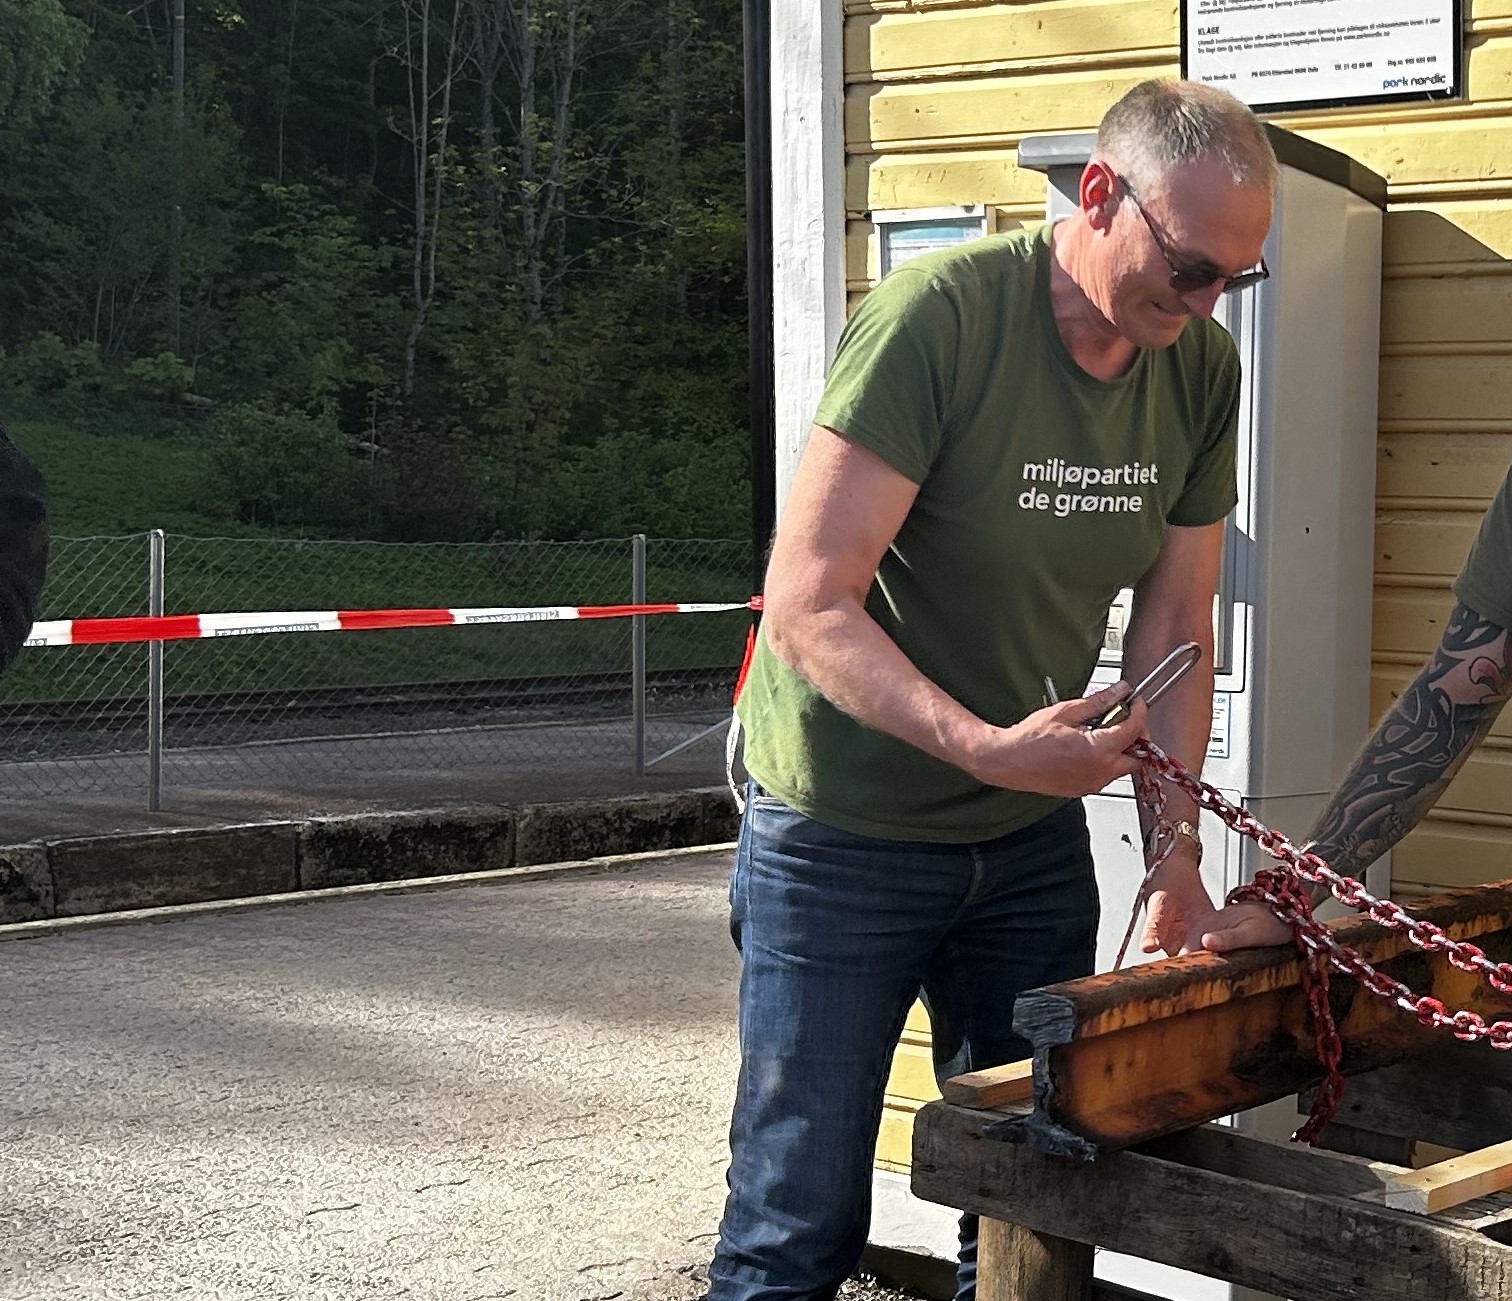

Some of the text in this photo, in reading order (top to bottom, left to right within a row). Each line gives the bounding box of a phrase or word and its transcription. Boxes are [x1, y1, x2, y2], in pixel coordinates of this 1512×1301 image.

[1383, 72, 1446, 90] park nordic
[1022, 457, 1159, 490] miljøpartiet
[1018, 486, 1143, 518] de grønne
